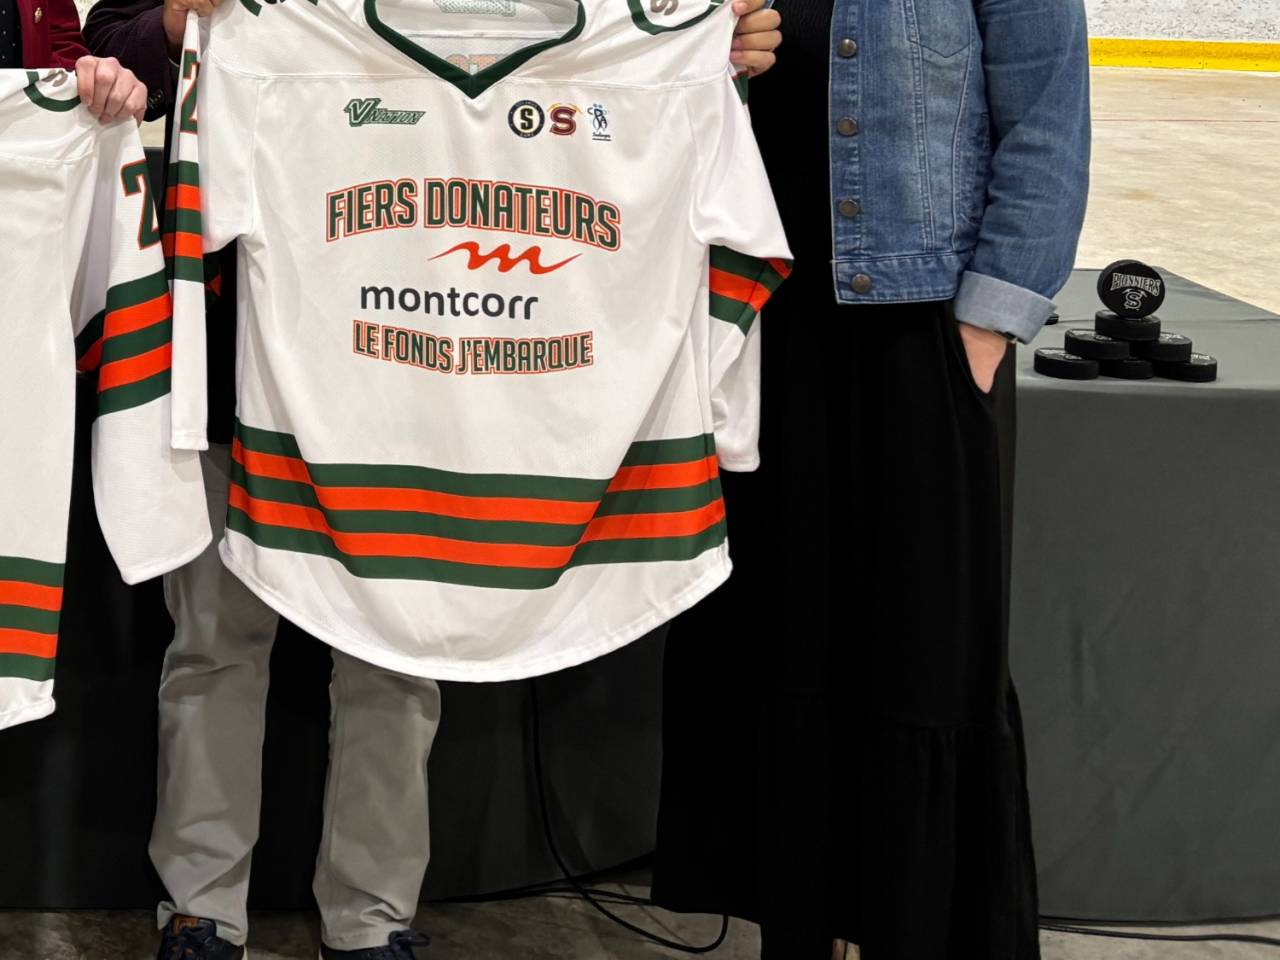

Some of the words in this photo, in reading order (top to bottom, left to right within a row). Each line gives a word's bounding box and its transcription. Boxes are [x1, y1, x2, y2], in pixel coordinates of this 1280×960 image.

[520, 108, 534, 130] S
[549, 106, 577, 136] S
[121, 159, 161, 251] 2
[326, 178, 418, 243] FIERS
[423, 177, 621, 252] DONATEURS
[359, 285, 539, 320] montcorr
[353, 320, 380, 359] LE
[381, 325, 455, 375] FONDS
[455, 330, 594, 375] J'EMBARQUE
